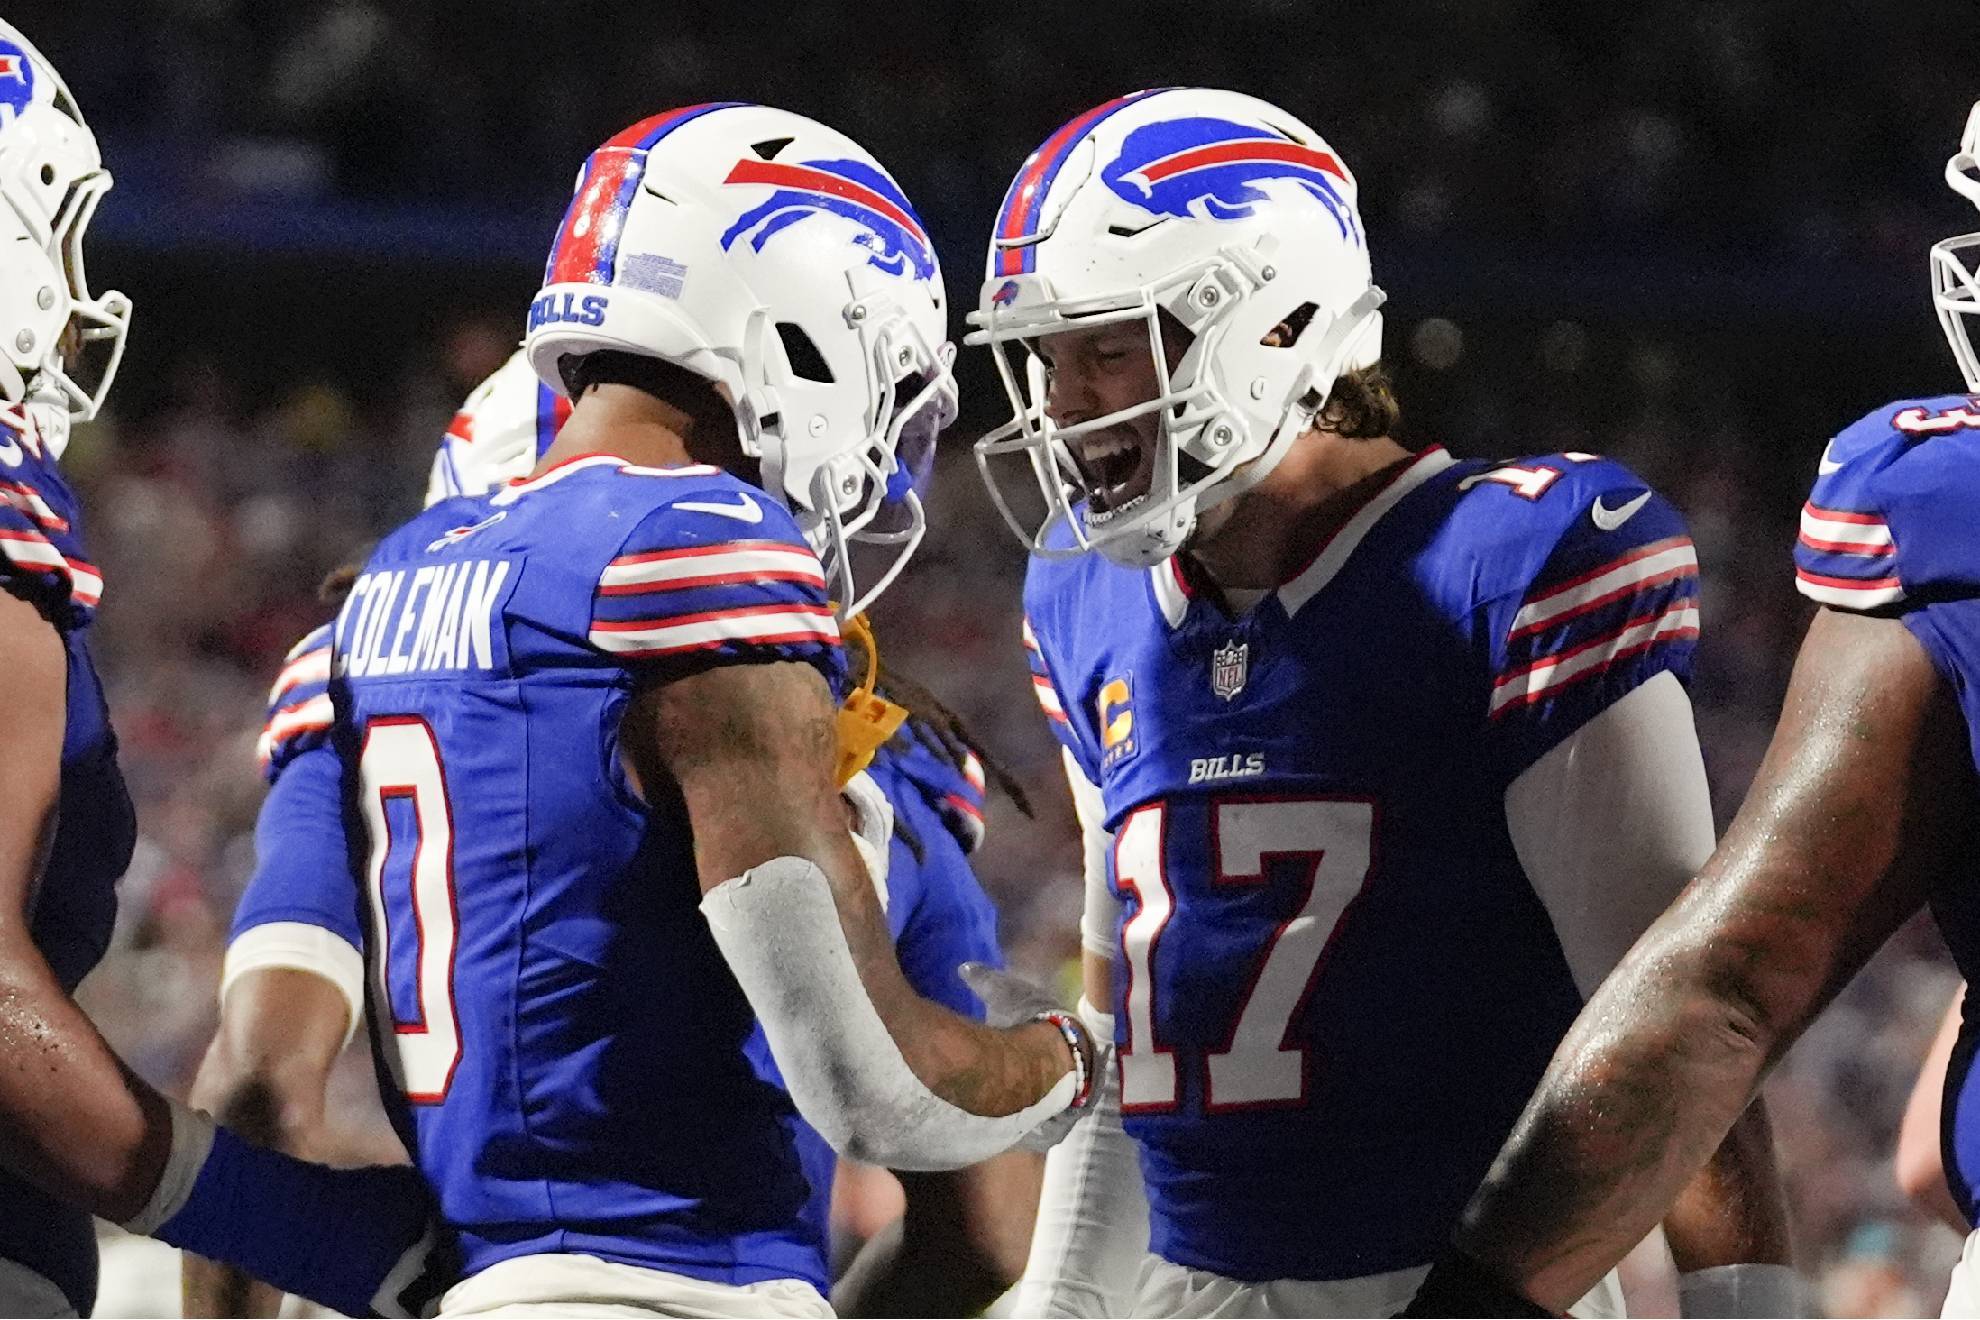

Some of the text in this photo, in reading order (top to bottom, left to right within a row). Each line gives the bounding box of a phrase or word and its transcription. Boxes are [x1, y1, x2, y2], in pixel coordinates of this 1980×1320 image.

[332, 559, 510, 678] COLEMAN
[1098, 677, 1134, 749] C
[1188, 751, 1266, 785] BILLS
[358, 713, 463, 1106] 0
[1113, 796, 1378, 1115] 17
